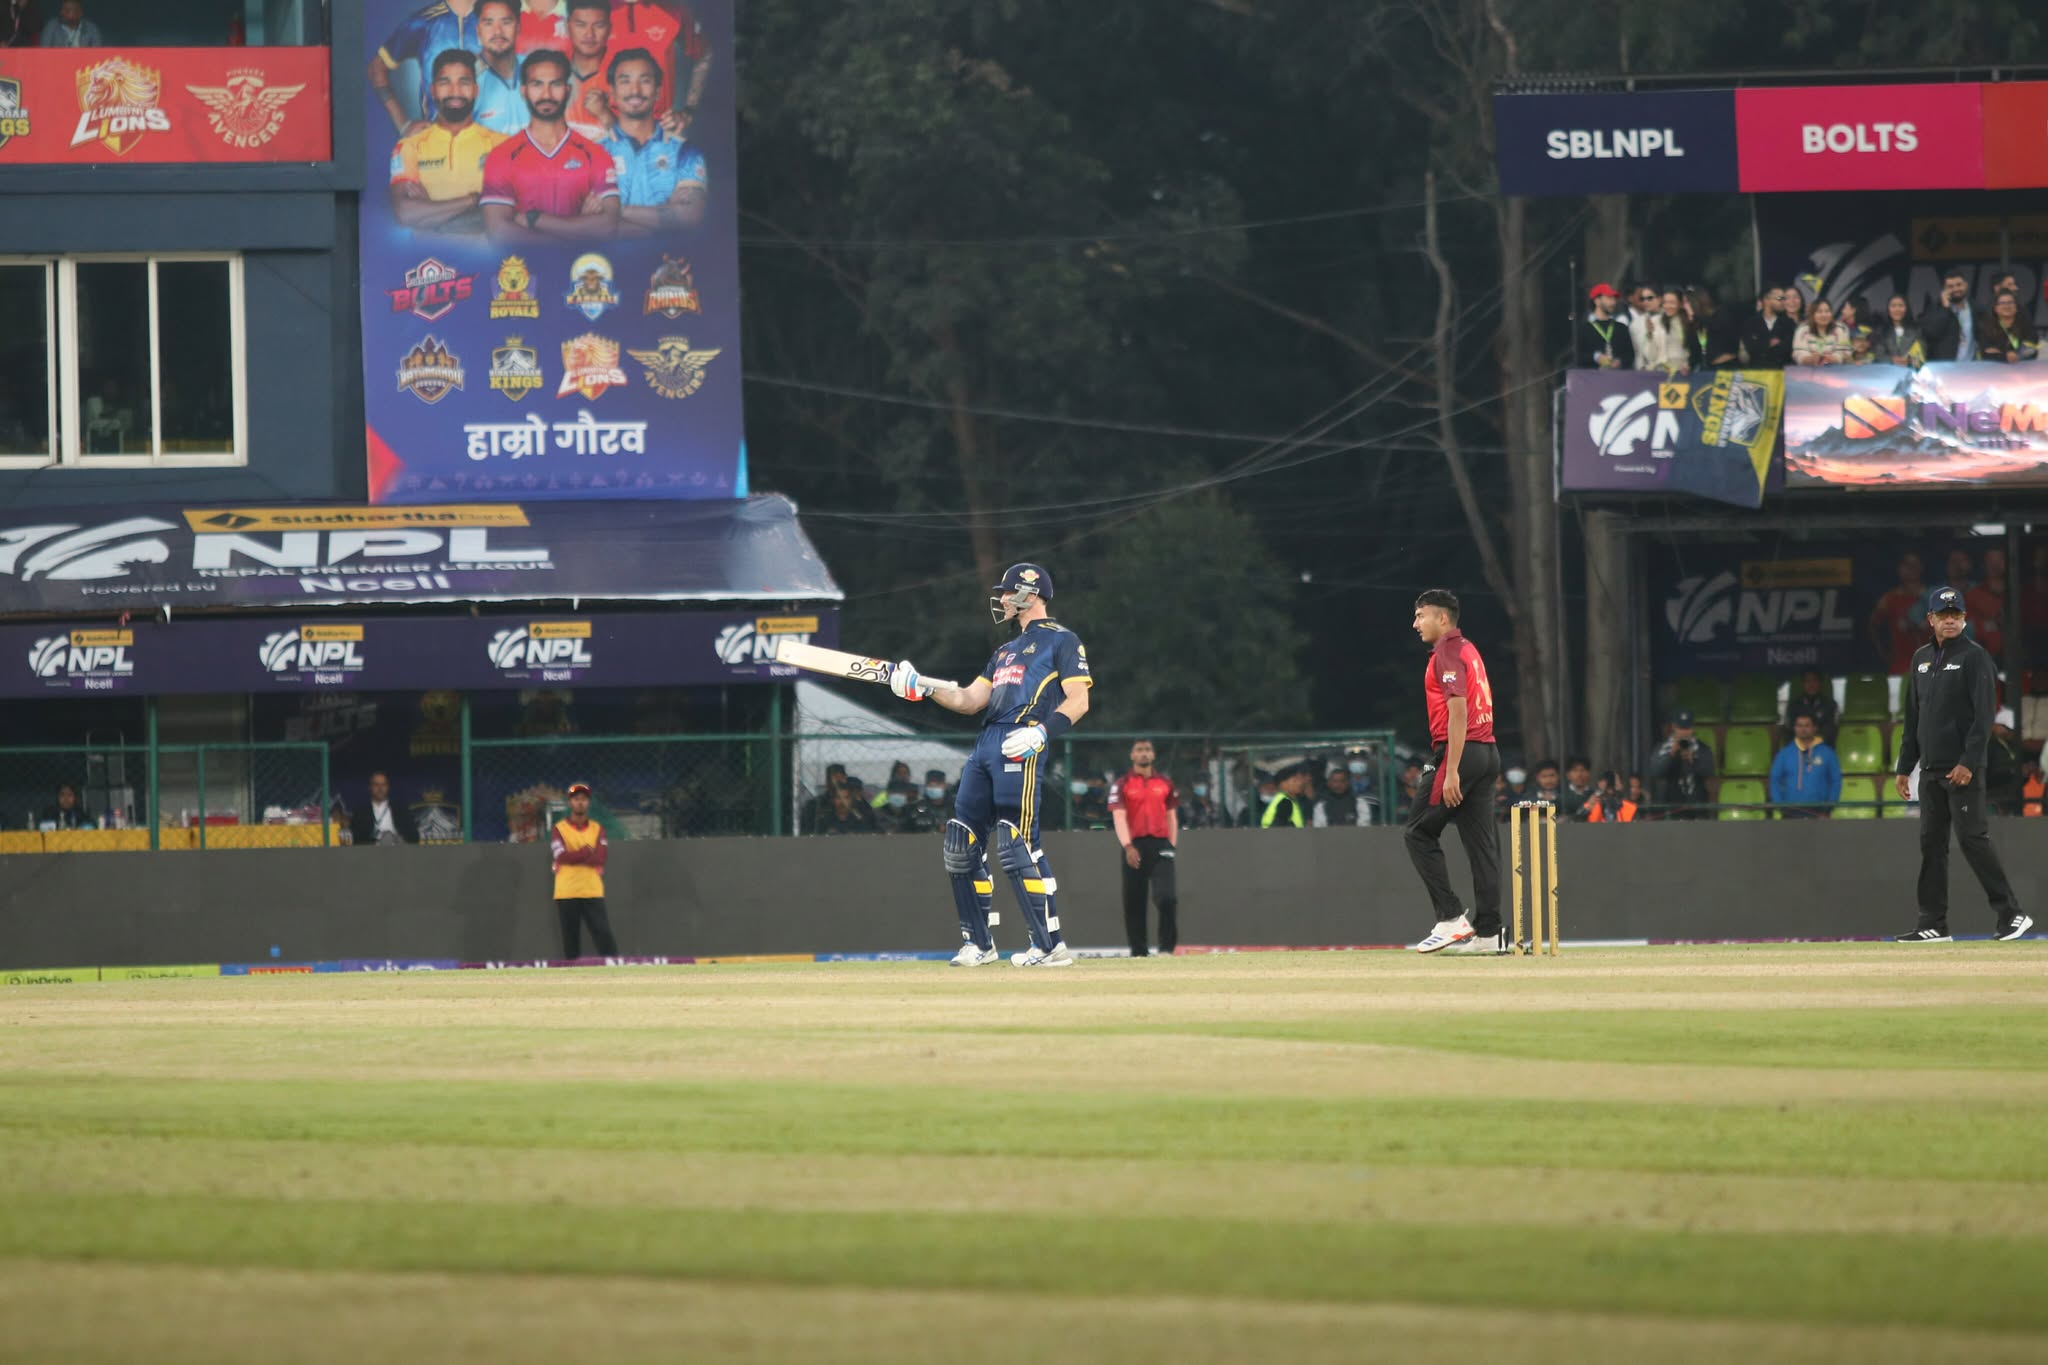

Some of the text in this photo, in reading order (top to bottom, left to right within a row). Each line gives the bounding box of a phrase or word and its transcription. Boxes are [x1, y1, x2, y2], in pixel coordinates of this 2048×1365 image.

[69, 108, 171, 148] LIONS
[208, 111, 285, 148] AVENGERS
[1802, 122, 1918, 153] BOLTS
[1546, 129, 1684, 159] SBLNPL
[490, 305, 539, 319] ROYALS
[489, 376, 543, 389] KINGS
[644, 370, 706, 399] AVENGERS
[1921, 402, 2048, 433] NeM
[463, 411, 648, 461] हाम्रो गौरव
[271, 512, 458, 524] Siddhartha
[193, 527, 549, 570] NPL
[199, 561, 555, 578] NEPAL PREMIER LEAGUE
[299, 572, 451, 593] Ncell
[81, 583, 180, 596] Powered
[1735, 589, 1853, 633] NPL
[67, 646, 134, 672] NPL
[298, 641, 364, 667] NPL
[526, 638, 592, 664] NPL
[85, 678, 113, 690] Ncell
[314, 673, 343, 684] Ncell
[543, 670, 572, 681] Ncell
[769, 665, 799, 677] Ncell
